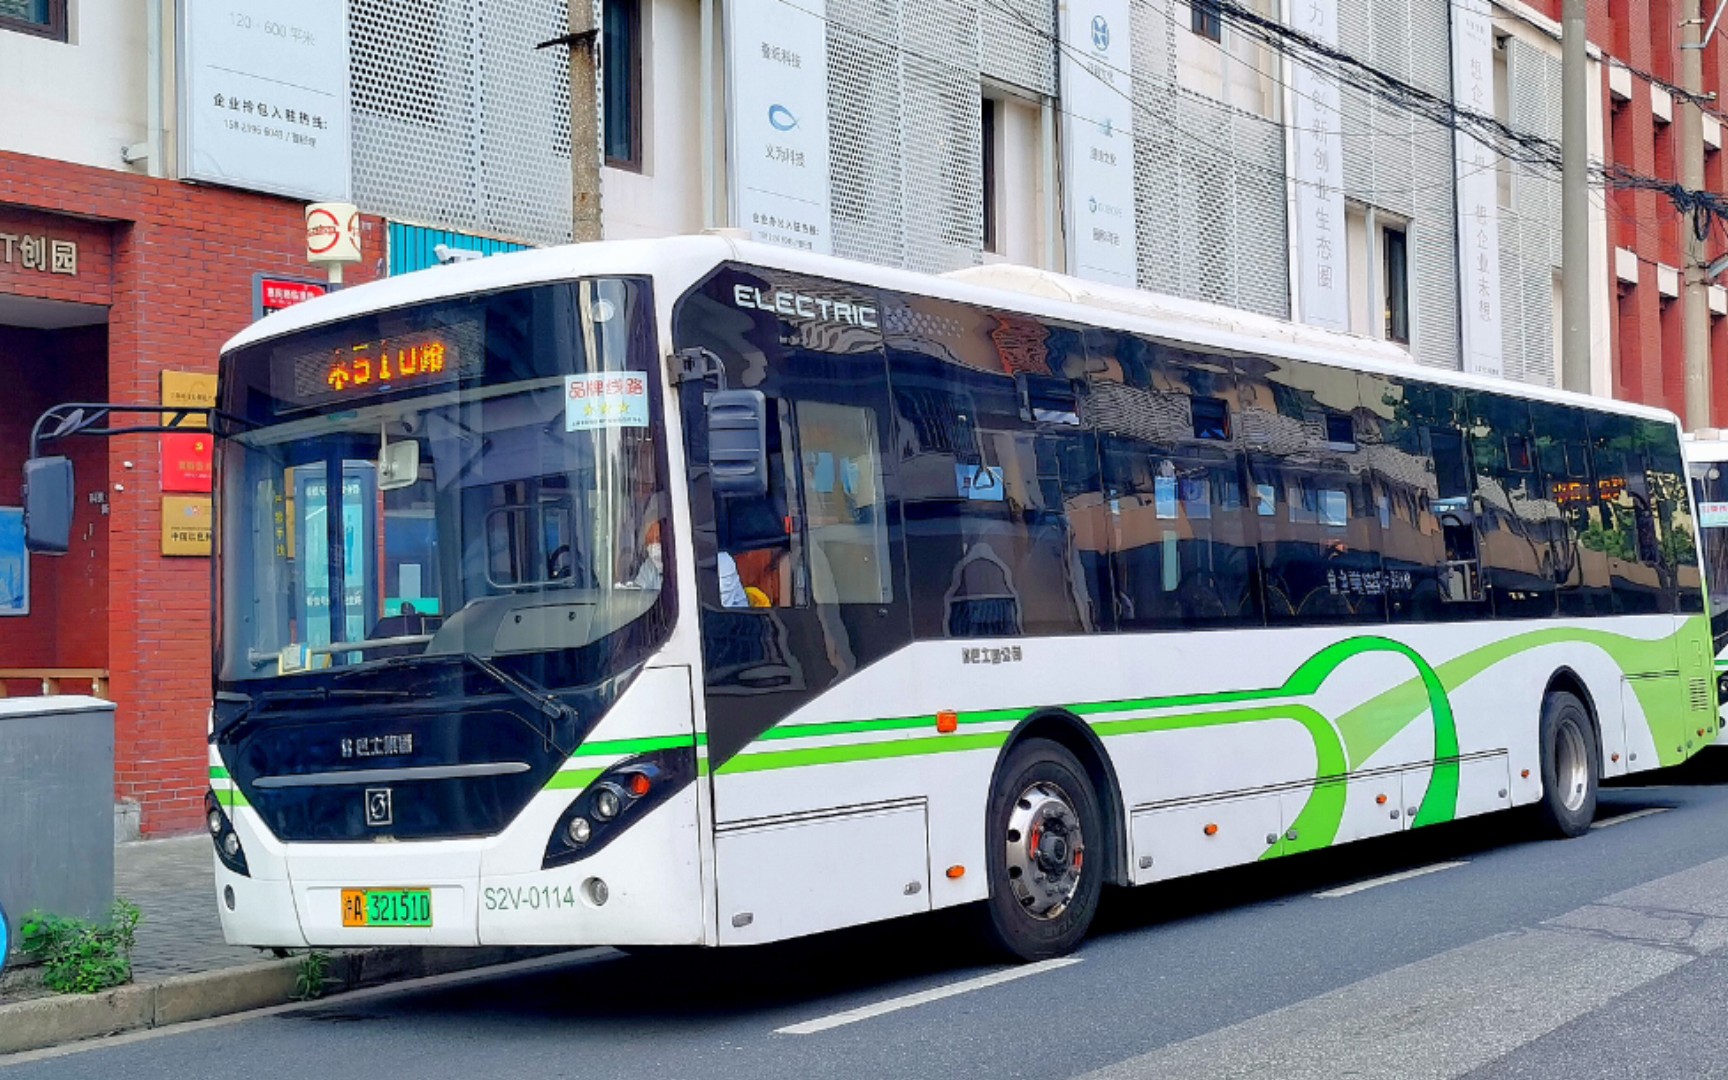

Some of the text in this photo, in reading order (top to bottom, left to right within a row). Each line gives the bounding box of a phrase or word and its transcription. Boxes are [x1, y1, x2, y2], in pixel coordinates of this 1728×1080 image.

[230, 12, 251, 29] 120
[264, 20, 287, 38] 600
[1309, 0, 1333, 290] 力创新创业生态圈
[733, 284, 878, 328] ELECTRIC
[569, 378, 643, 399] 品牌线路
[370, 894, 430, 921] 32151D
[484, 886, 575, 910] S2V-0114
